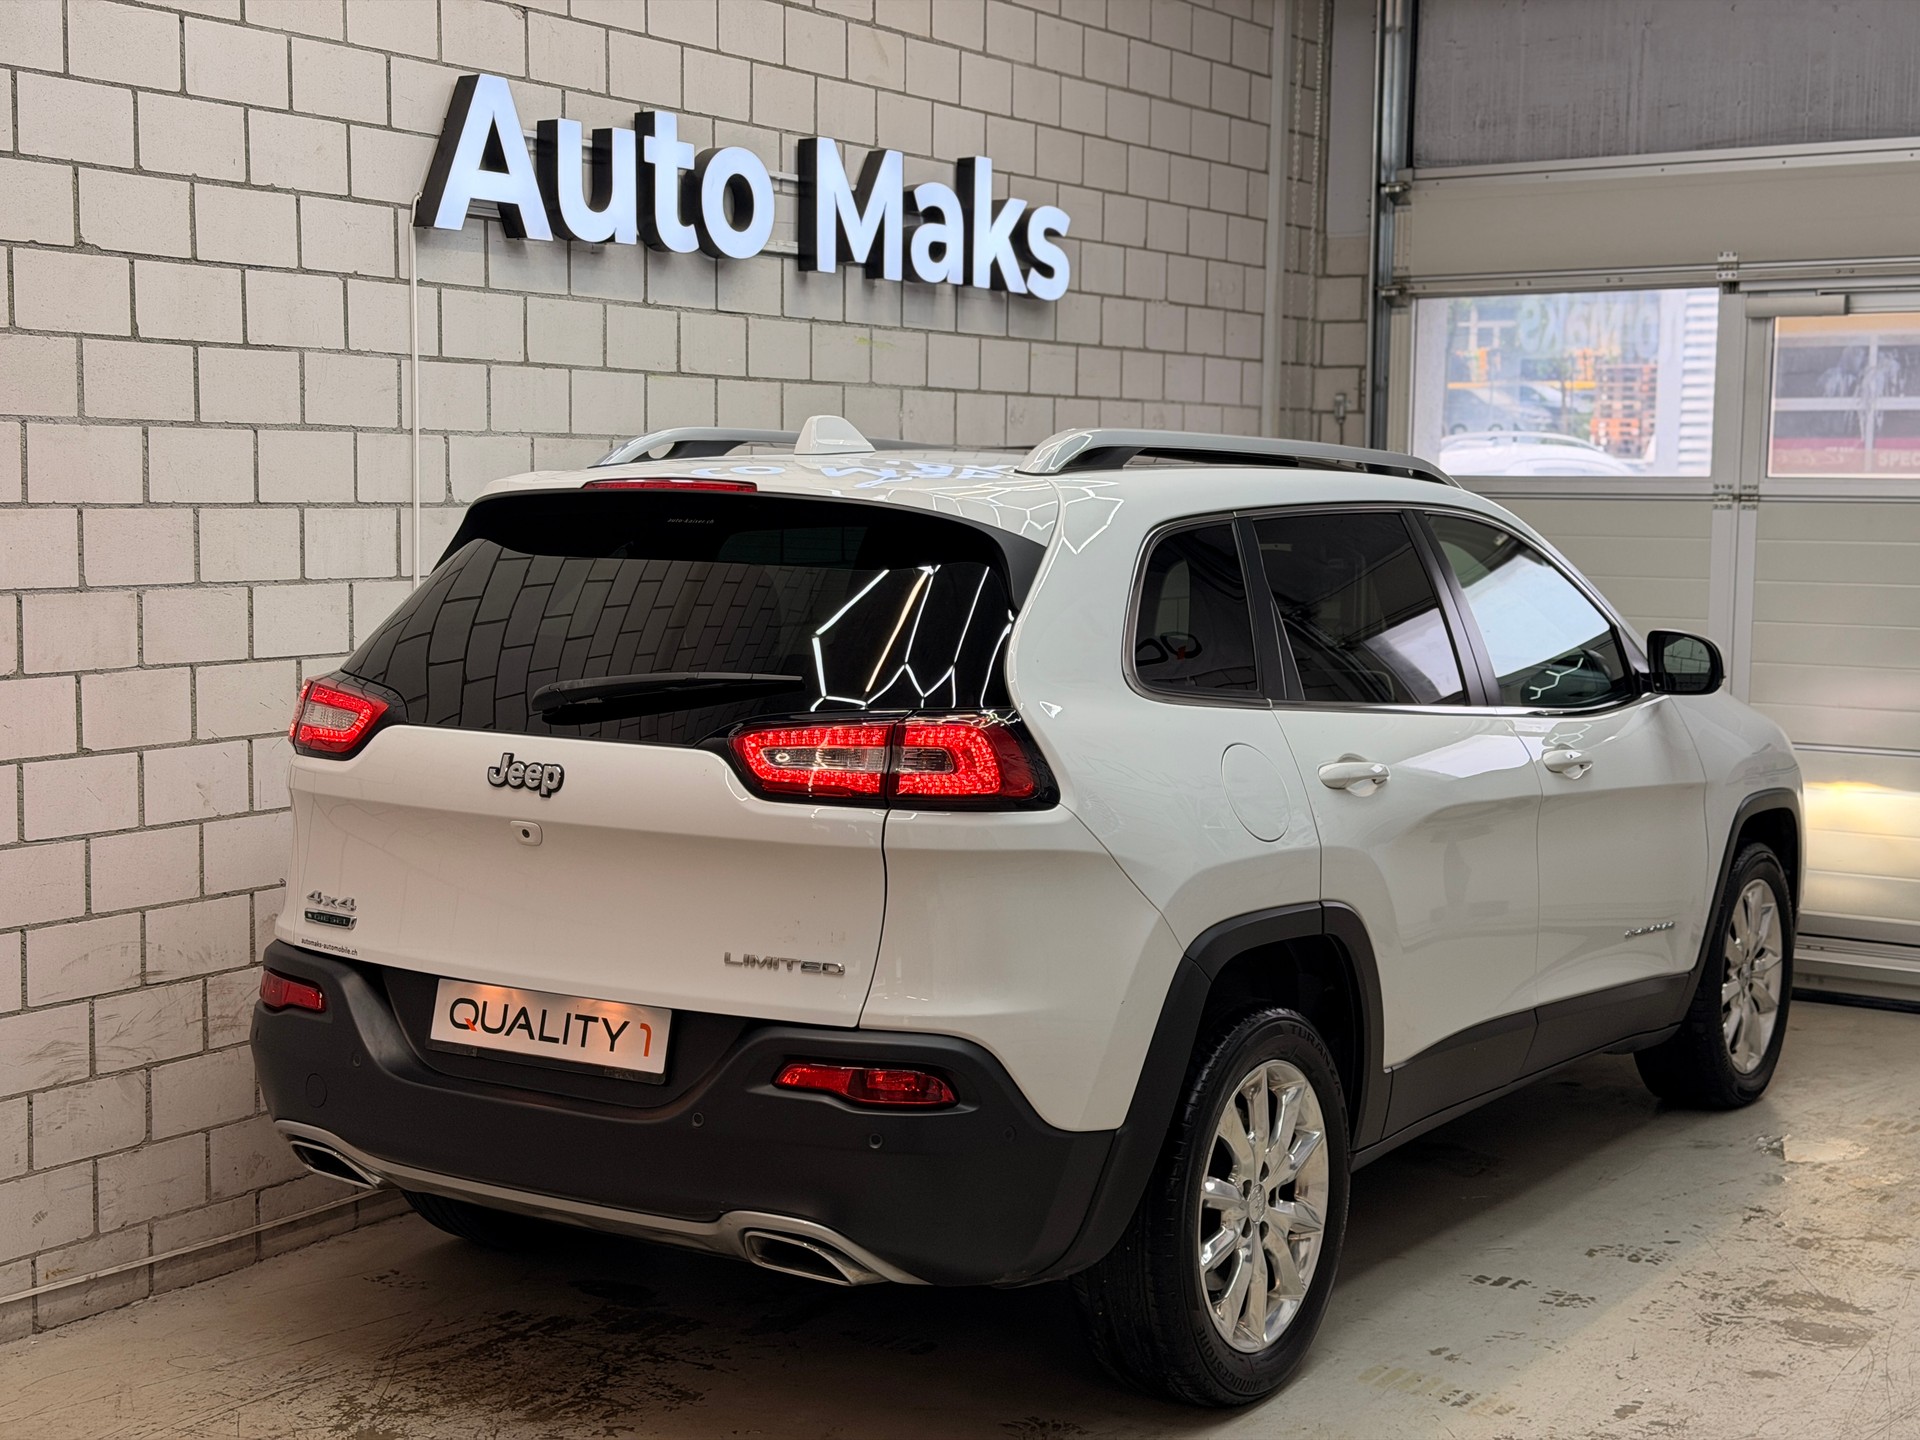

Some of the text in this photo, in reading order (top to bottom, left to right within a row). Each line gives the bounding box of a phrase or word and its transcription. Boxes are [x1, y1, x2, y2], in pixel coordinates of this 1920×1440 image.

[415, 73, 1071, 301] Auto Maks
[487, 752, 565, 798] Jeep
[307, 890, 357, 911] 4x4
[301, 938, 358, 955] automaks-automobile.ch
[724, 952, 846, 976] LIMITED
[449, 997, 652, 1057] QUALITY 1
